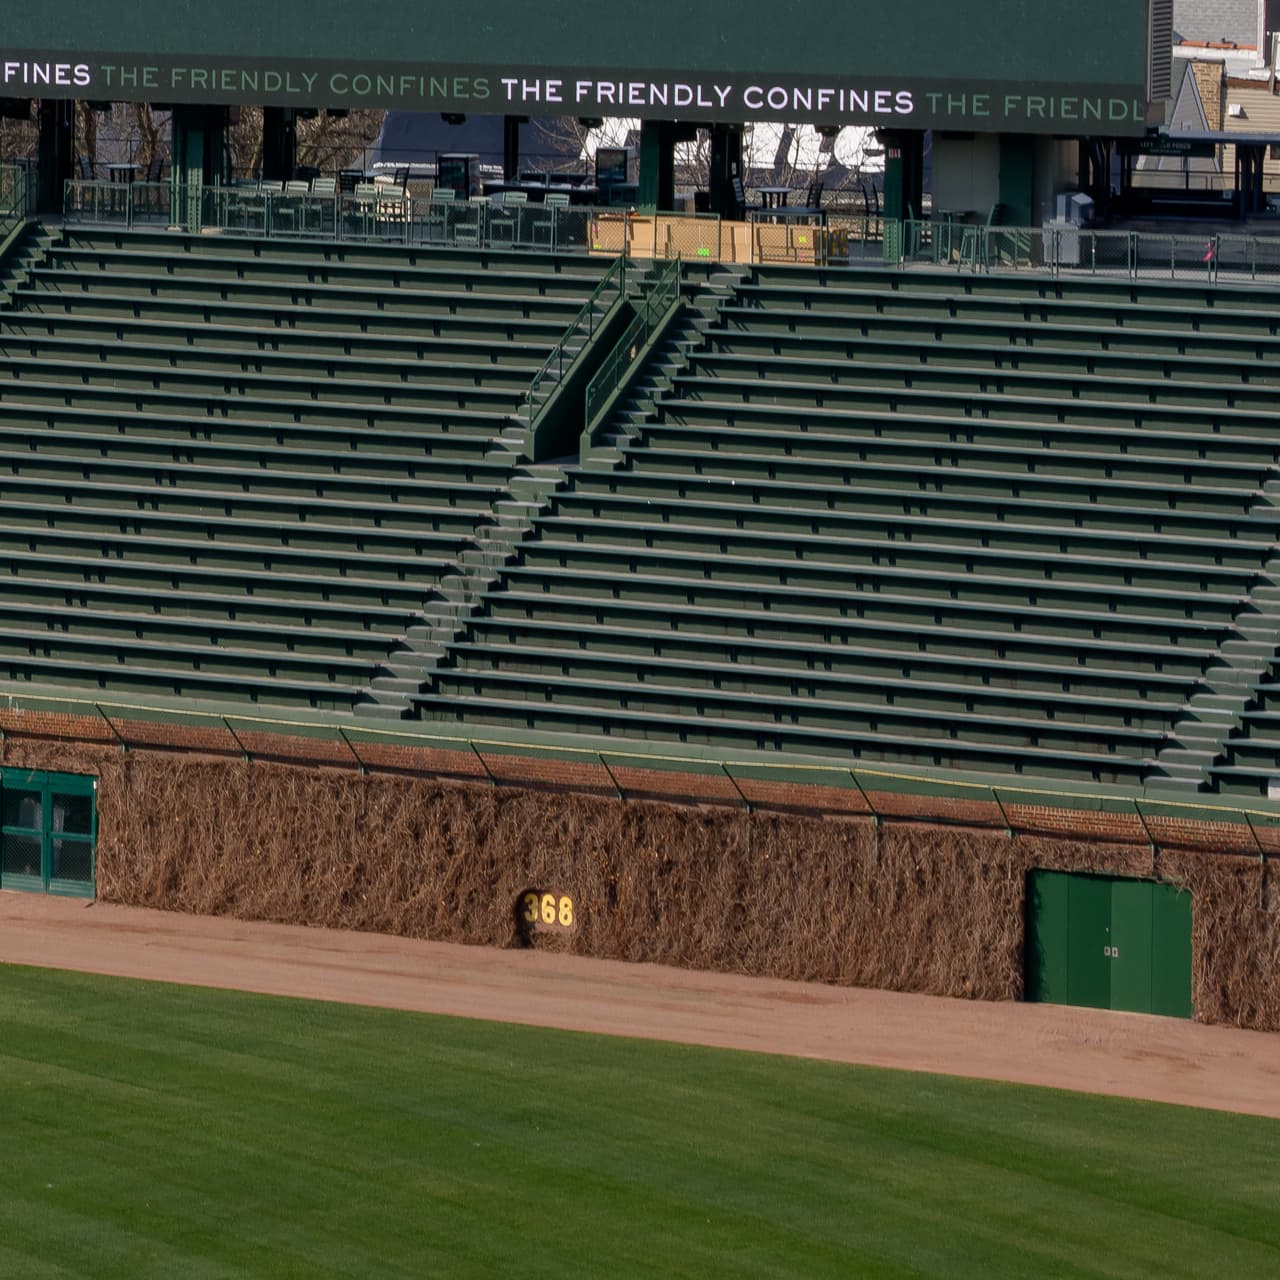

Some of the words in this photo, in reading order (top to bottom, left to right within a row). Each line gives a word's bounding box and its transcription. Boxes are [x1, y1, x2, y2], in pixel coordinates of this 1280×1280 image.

[101, 65, 159, 89] THE
[171, 67, 319, 96] FRIENDLY
[329, 73, 490, 100] CONFINES
[500, 78, 563, 103] THE
[575, 81, 732, 109] FRIENDLY
[743, 86, 915, 115] CONFINES
[926, 93, 997, 118] THE
[523, 892, 574, 927] 368
